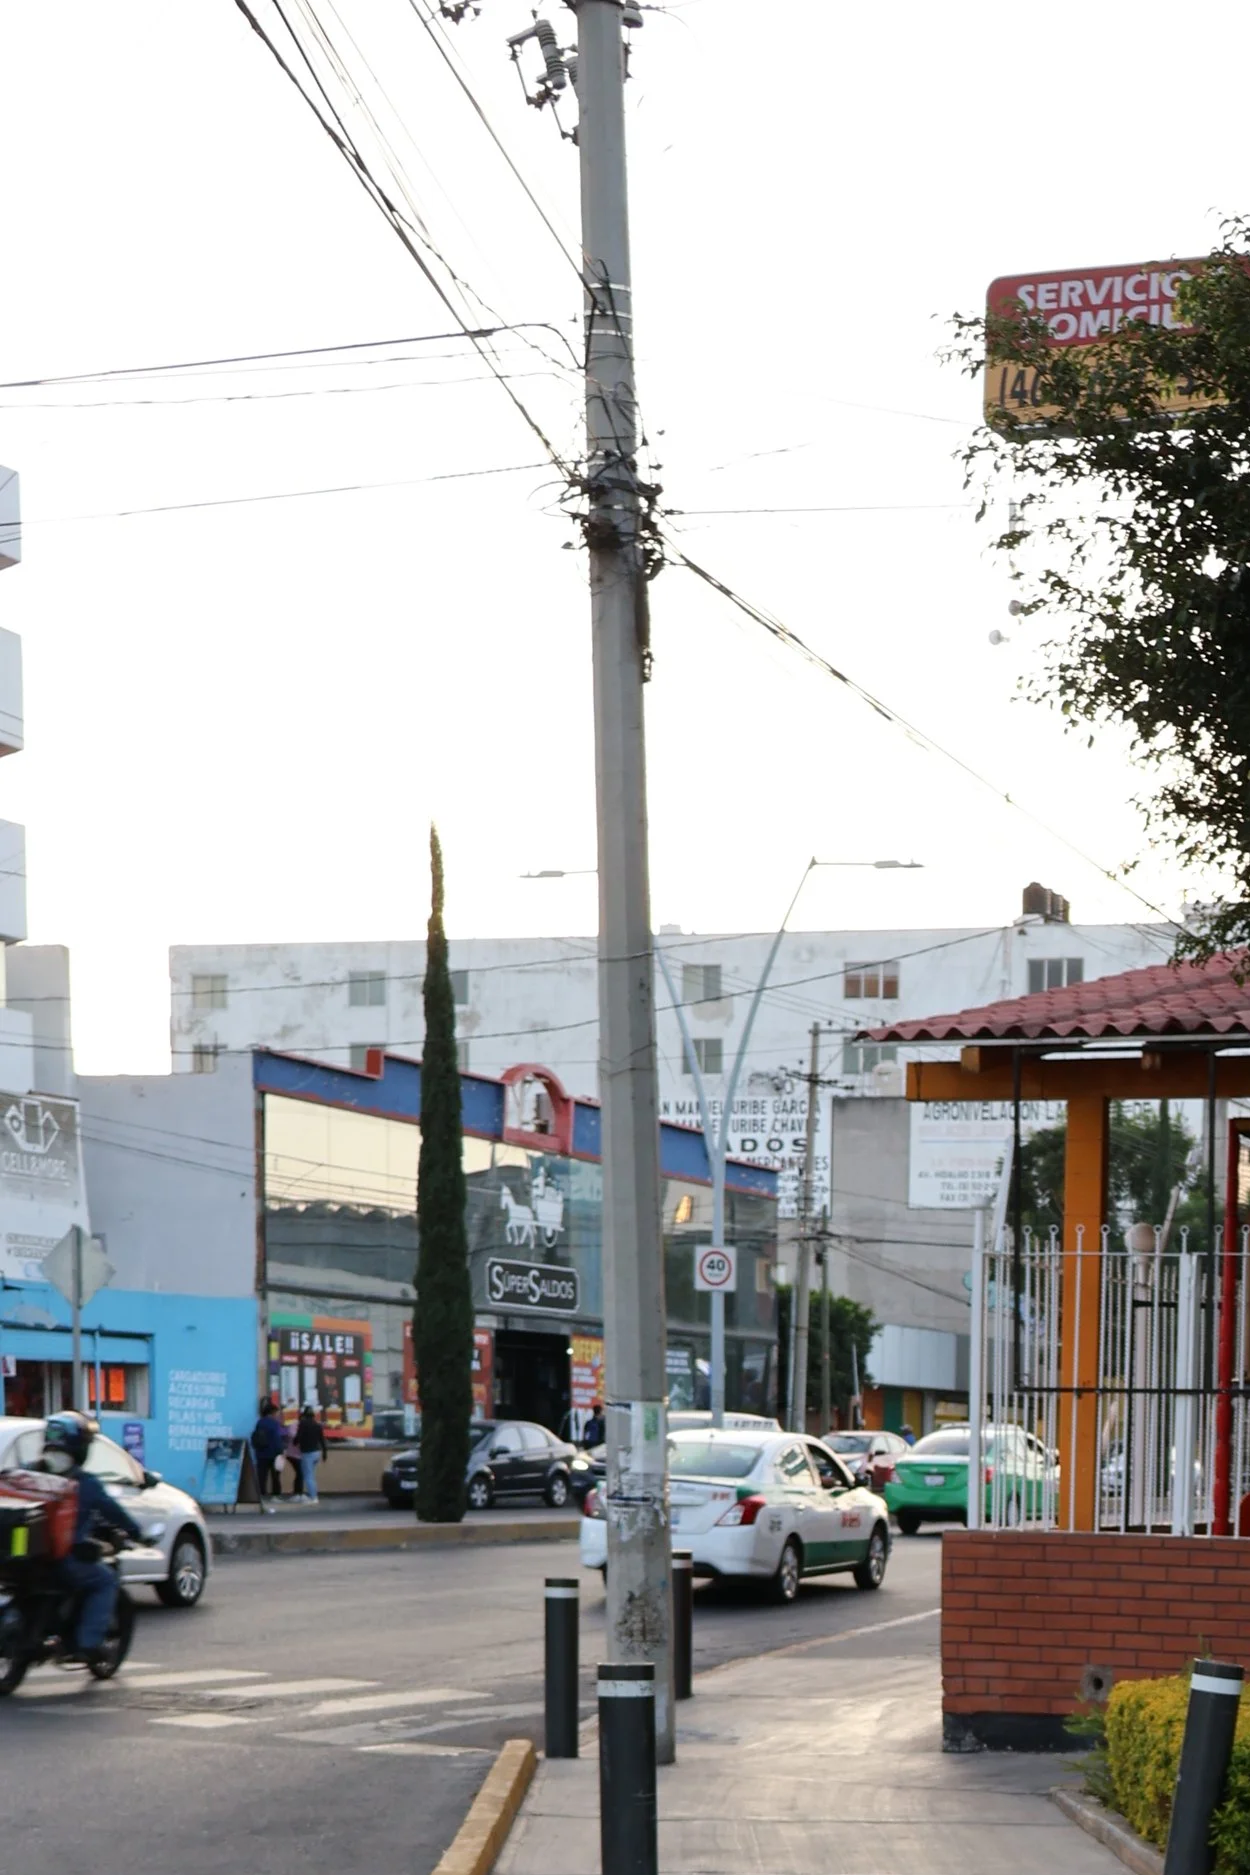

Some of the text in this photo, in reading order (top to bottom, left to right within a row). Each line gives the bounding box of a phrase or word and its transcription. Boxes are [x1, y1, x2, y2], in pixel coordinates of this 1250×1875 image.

[1017, 271, 1193, 311] SERVICIO
[773, 1101, 821, 1115] GARCA
[732, 1119, 767, 1133] URIBE
[772, 1118, 820, 1133] CHAVZ
[707, 1259, 725, 1271] 40
